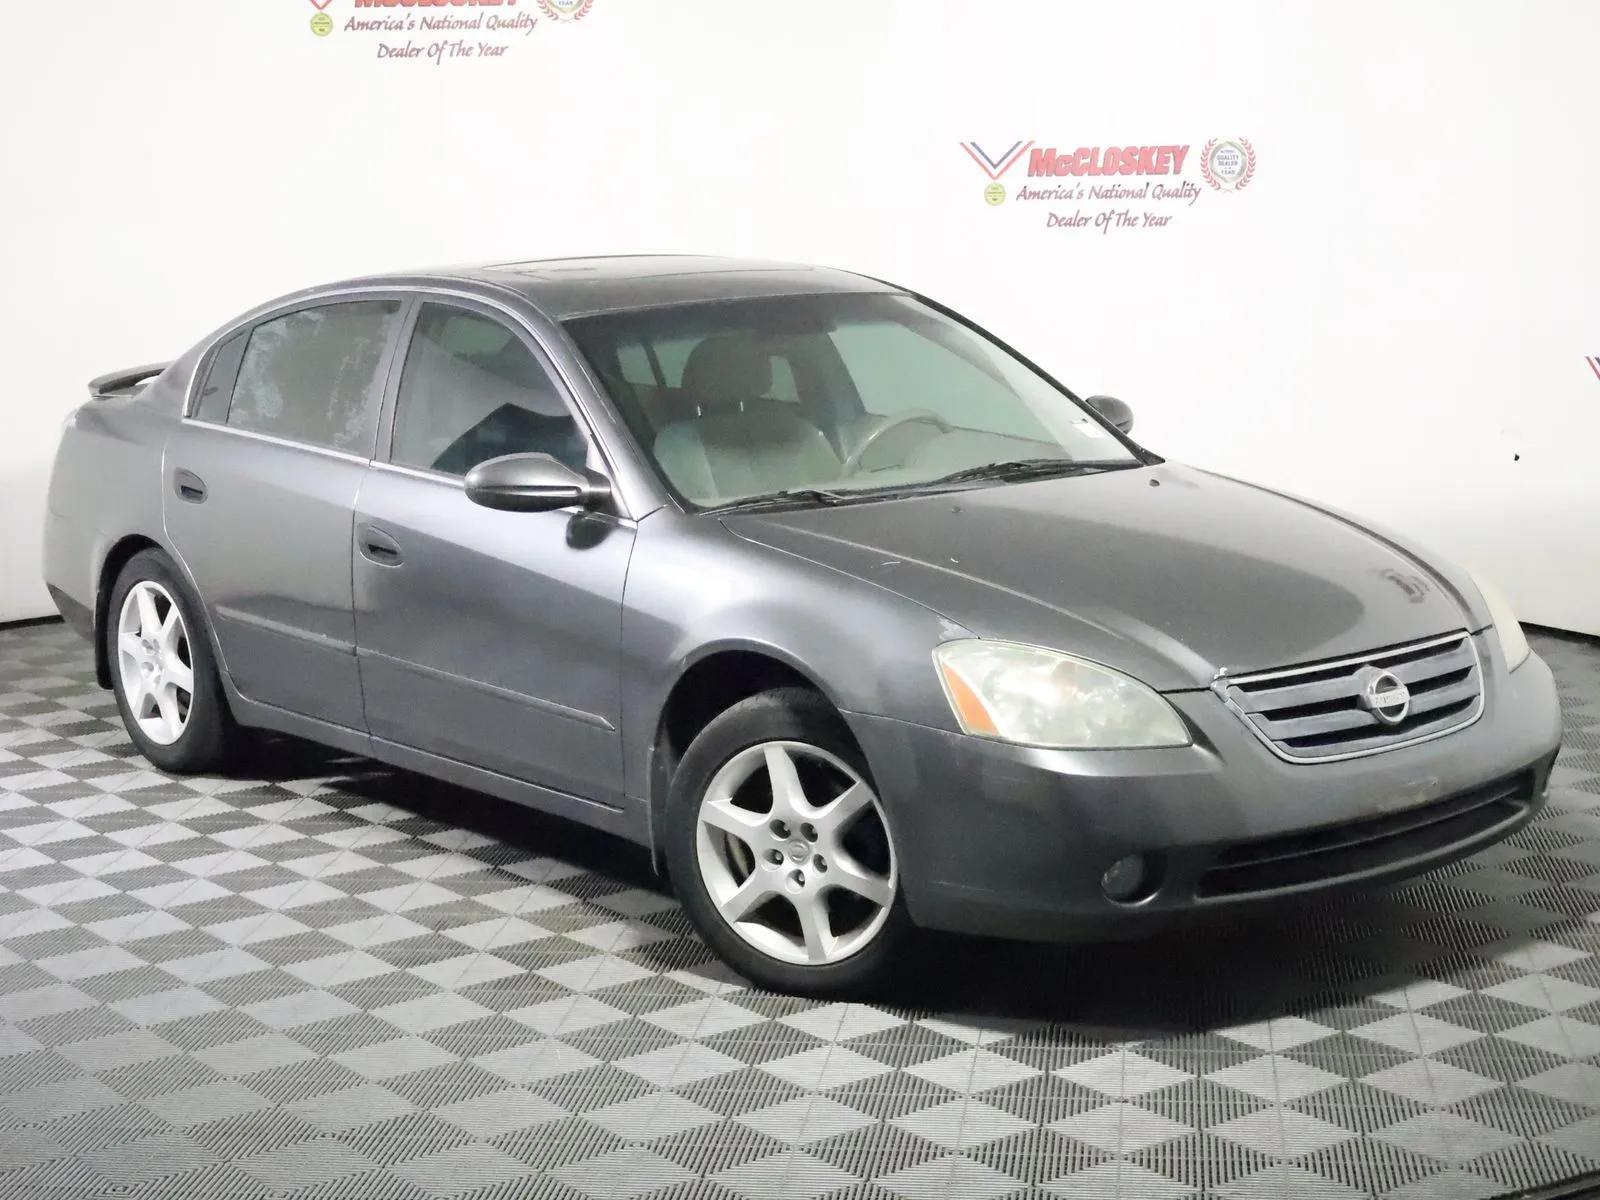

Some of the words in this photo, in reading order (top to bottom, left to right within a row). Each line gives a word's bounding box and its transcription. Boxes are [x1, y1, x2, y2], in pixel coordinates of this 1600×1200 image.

[344, 14, 415, 32] America's
[420, 12, 482, 31] National
[486, 11, 538, 36] Quality
[377, 41, 424, 59] Dealer
[427, 40, 448, 66] Of
[448, 41, 473, 58] The
[477, 42, 509, 58] Year
[1027, 145, 1190, 178] McCLOSKEY
[1016, 182, 1084, 201] America's
[1088, 181, 1149, 200] National
[1151, 180, 1201, 207] Quality
[1046, 209, 1092, 228] Dealer
[1095, 209, 1116, 235] Of
[1115, 209, 1139, 228] The
[1142, 212, 1173, 228] Year
